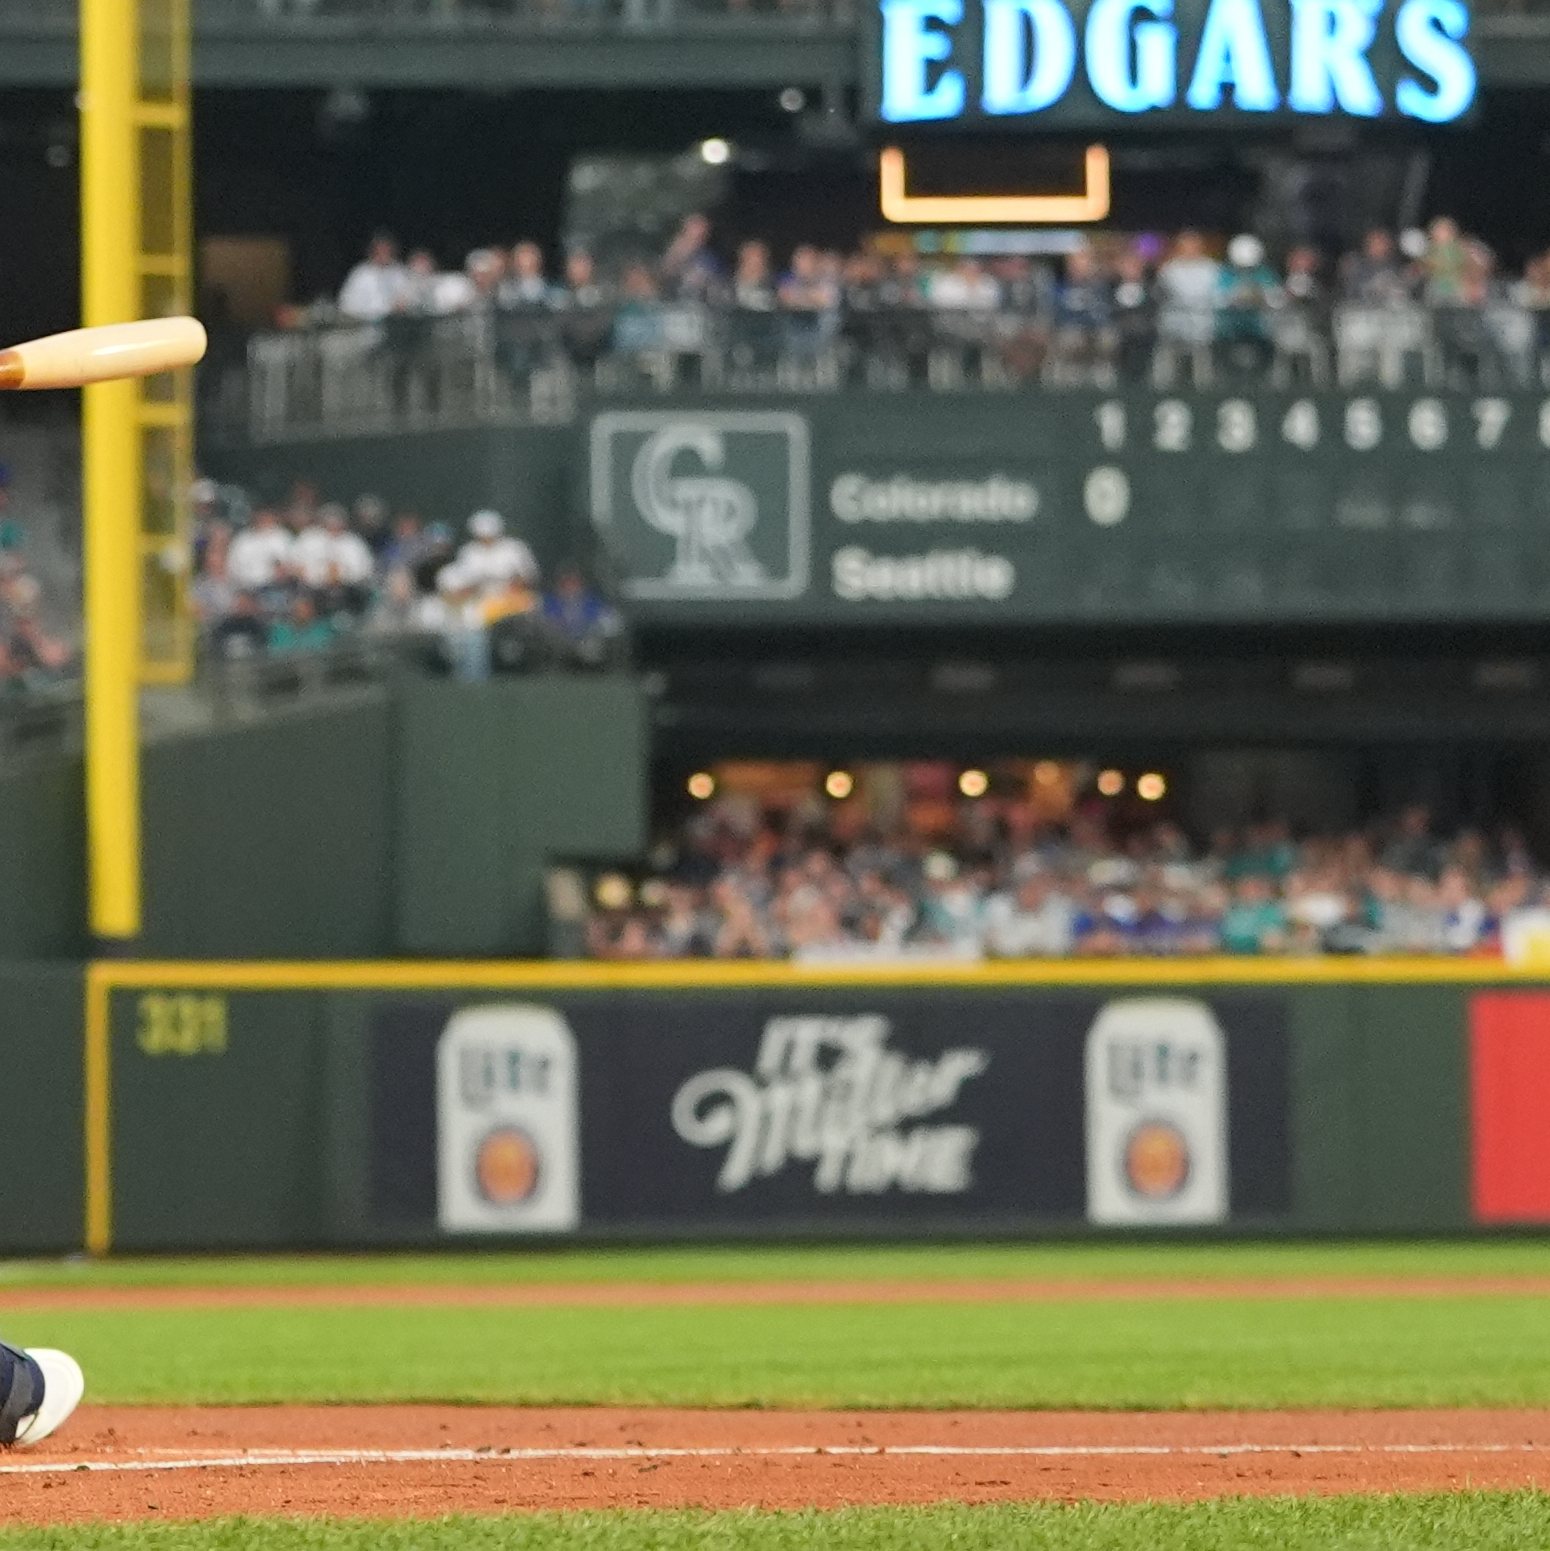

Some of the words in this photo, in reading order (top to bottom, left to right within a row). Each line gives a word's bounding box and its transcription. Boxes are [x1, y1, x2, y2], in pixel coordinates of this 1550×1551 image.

[1095, 399, 1127, 450] 1
[1152, 399, 1192, 450] 2
[1217, 399, 1256, 450] 3
[1282, 399, 1319, 450] 4
[1344, 399, 1382, 450] 5
[1408, 399, 1447, 450] 6
[1473, 399, 1511, 450] 7
[830, 474, 1038, 524] Colorado
[1084, 465, 1131, 526] 0
[830, 546, 1015, 601] Seattle
